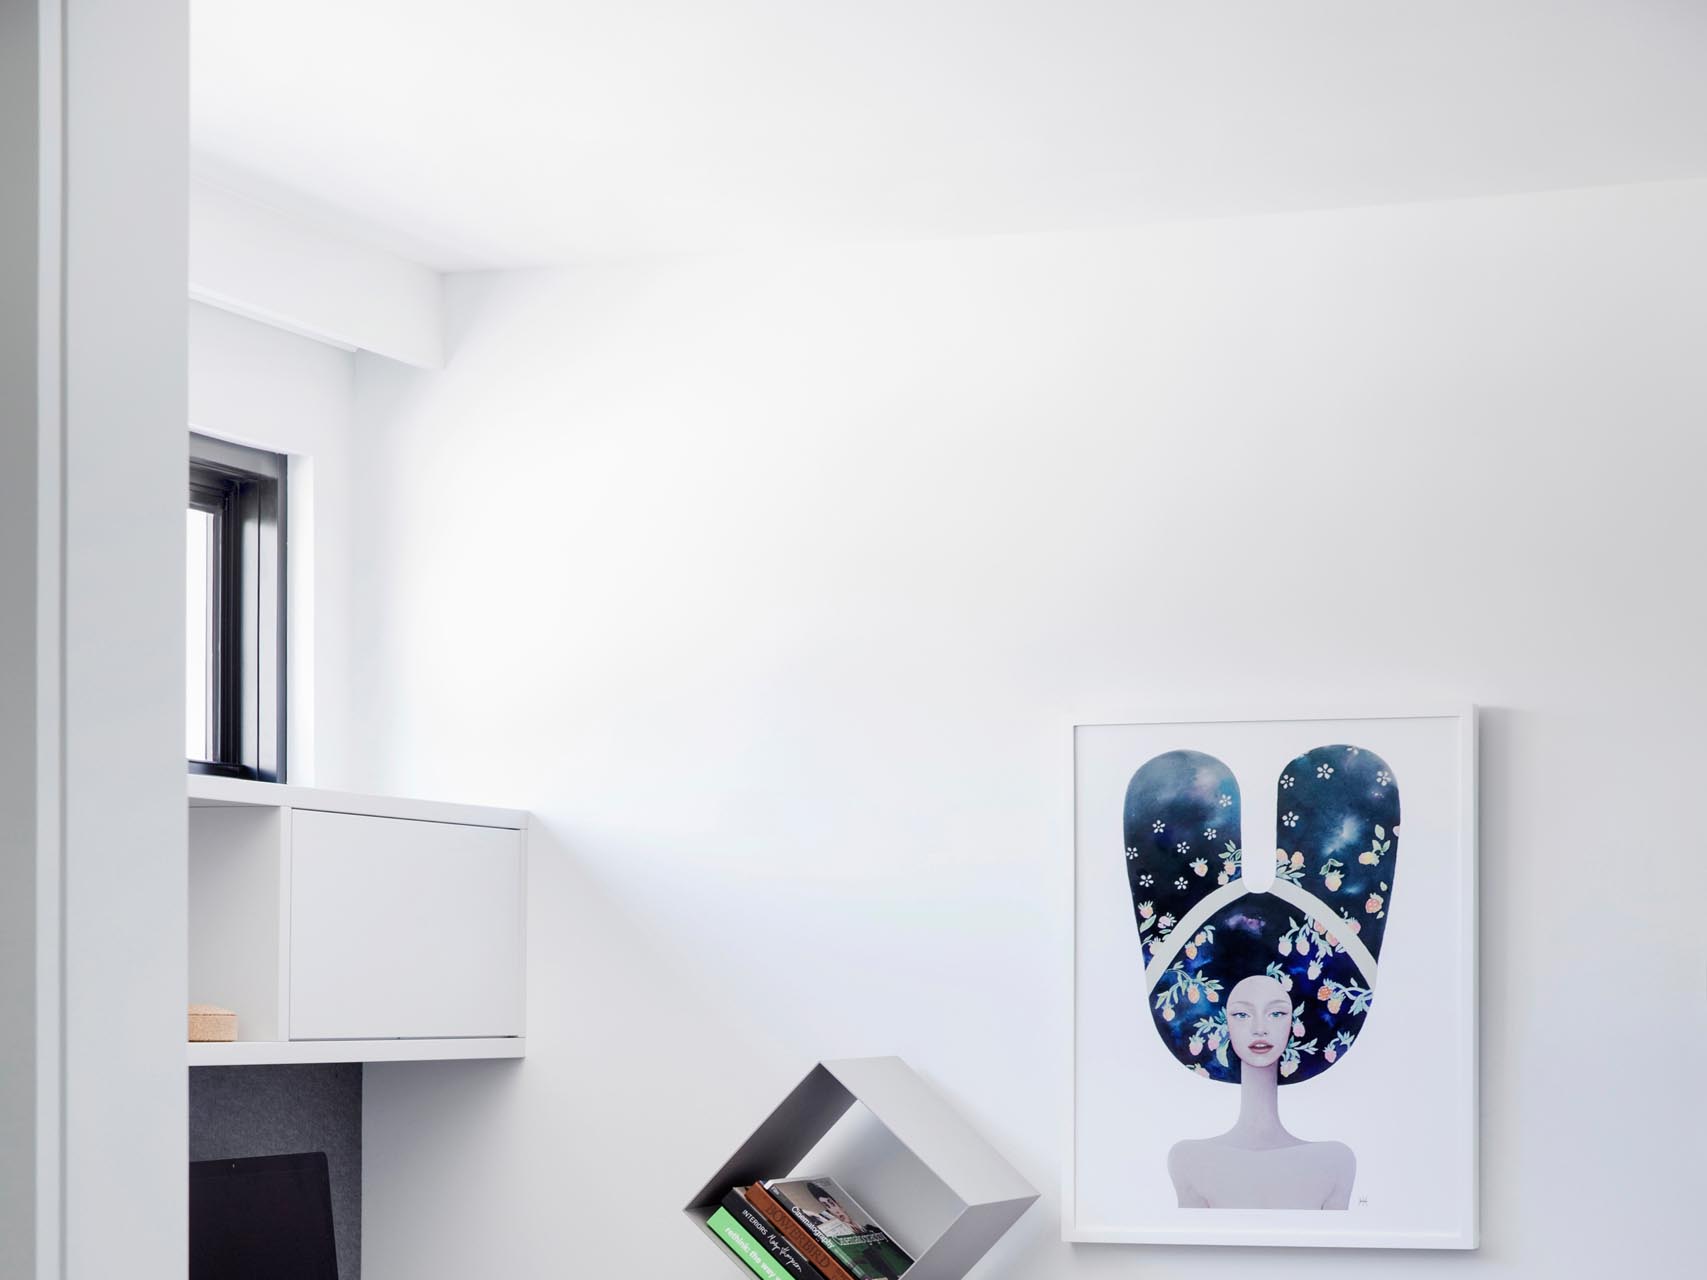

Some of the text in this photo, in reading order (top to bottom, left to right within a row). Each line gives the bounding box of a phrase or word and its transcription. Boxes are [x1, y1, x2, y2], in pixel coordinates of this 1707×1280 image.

[742, 1210, 769, 1236] INTERIORS
[765, 1202, 831, 1269] BOWERBIRD
[791, 1206, 835, 1250] Cinematography
[749, 1250, 761, 1265] the
[760, 1262, 777, 1279] way
